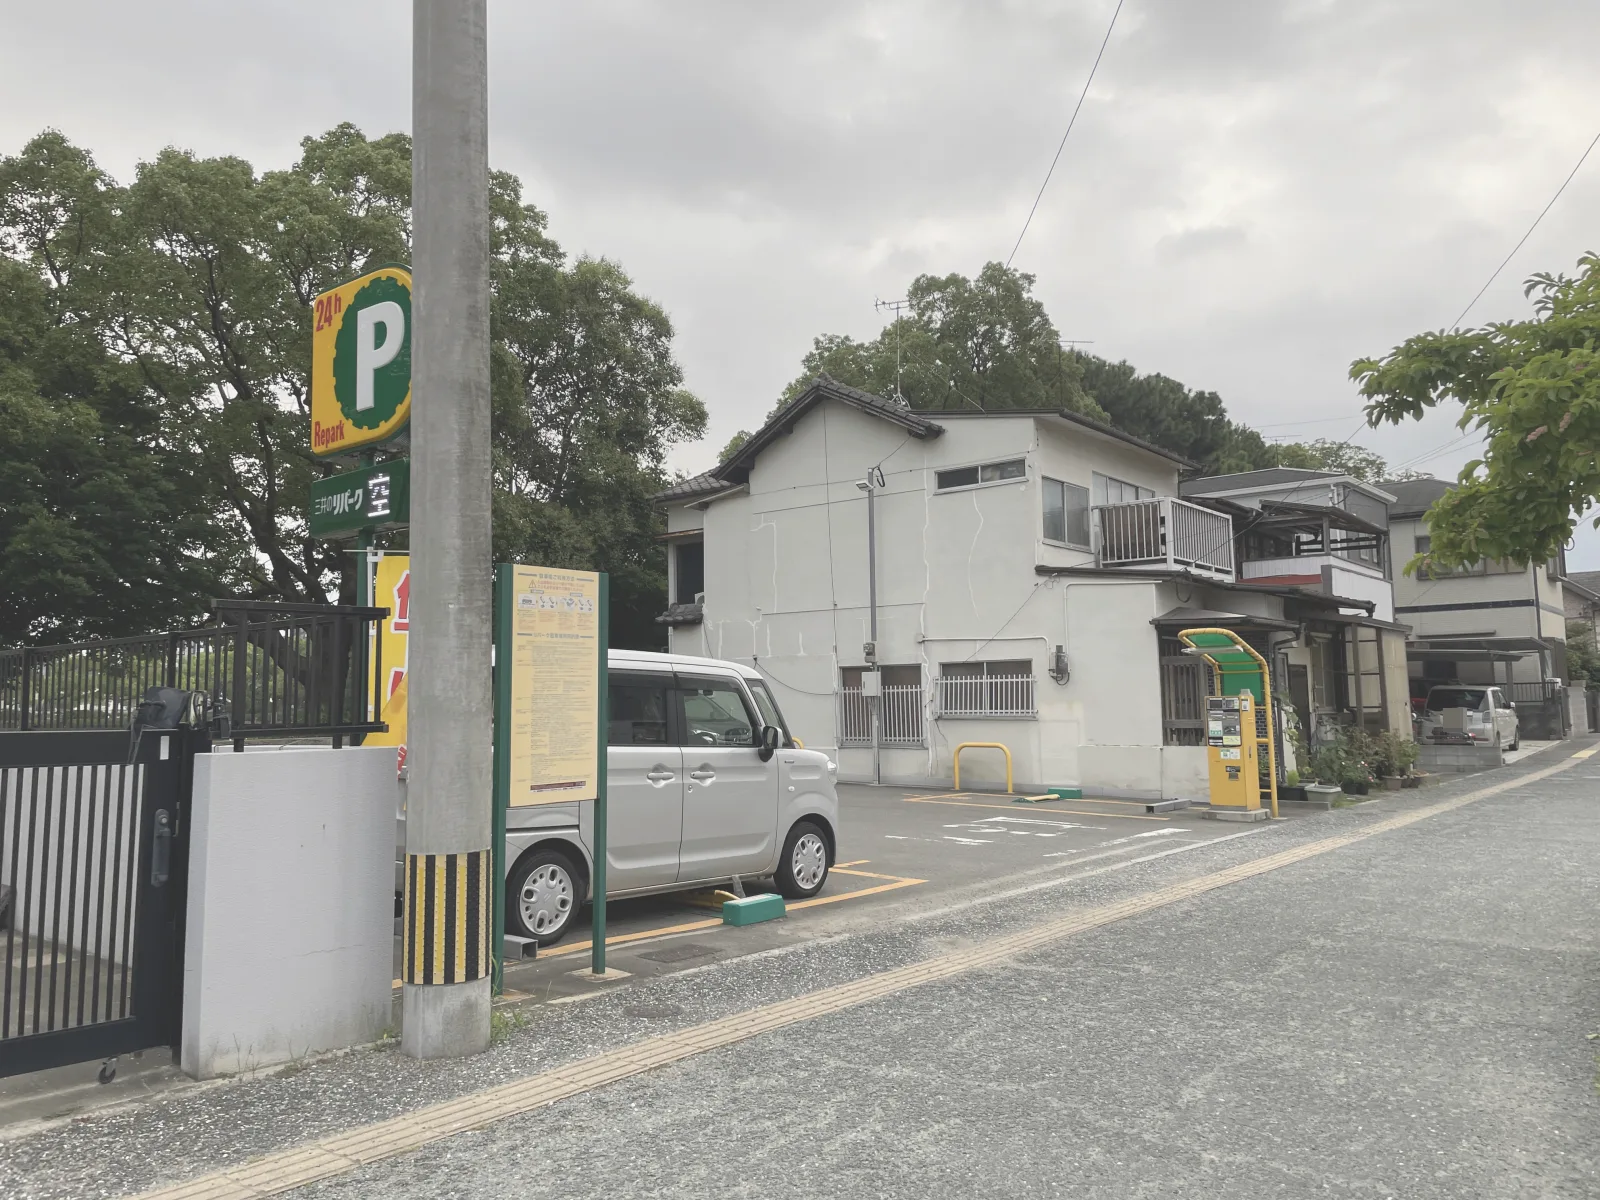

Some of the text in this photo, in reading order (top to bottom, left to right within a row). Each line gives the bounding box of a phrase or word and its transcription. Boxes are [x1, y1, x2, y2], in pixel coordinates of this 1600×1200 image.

[316, 293, 342, 332] 24h
[356, 301, 405, 412] P
[314, 420, 345, 448] Repark
[315, 488, 363, 515] 三井のリパーク
[367, 473, 391, 517] 空
